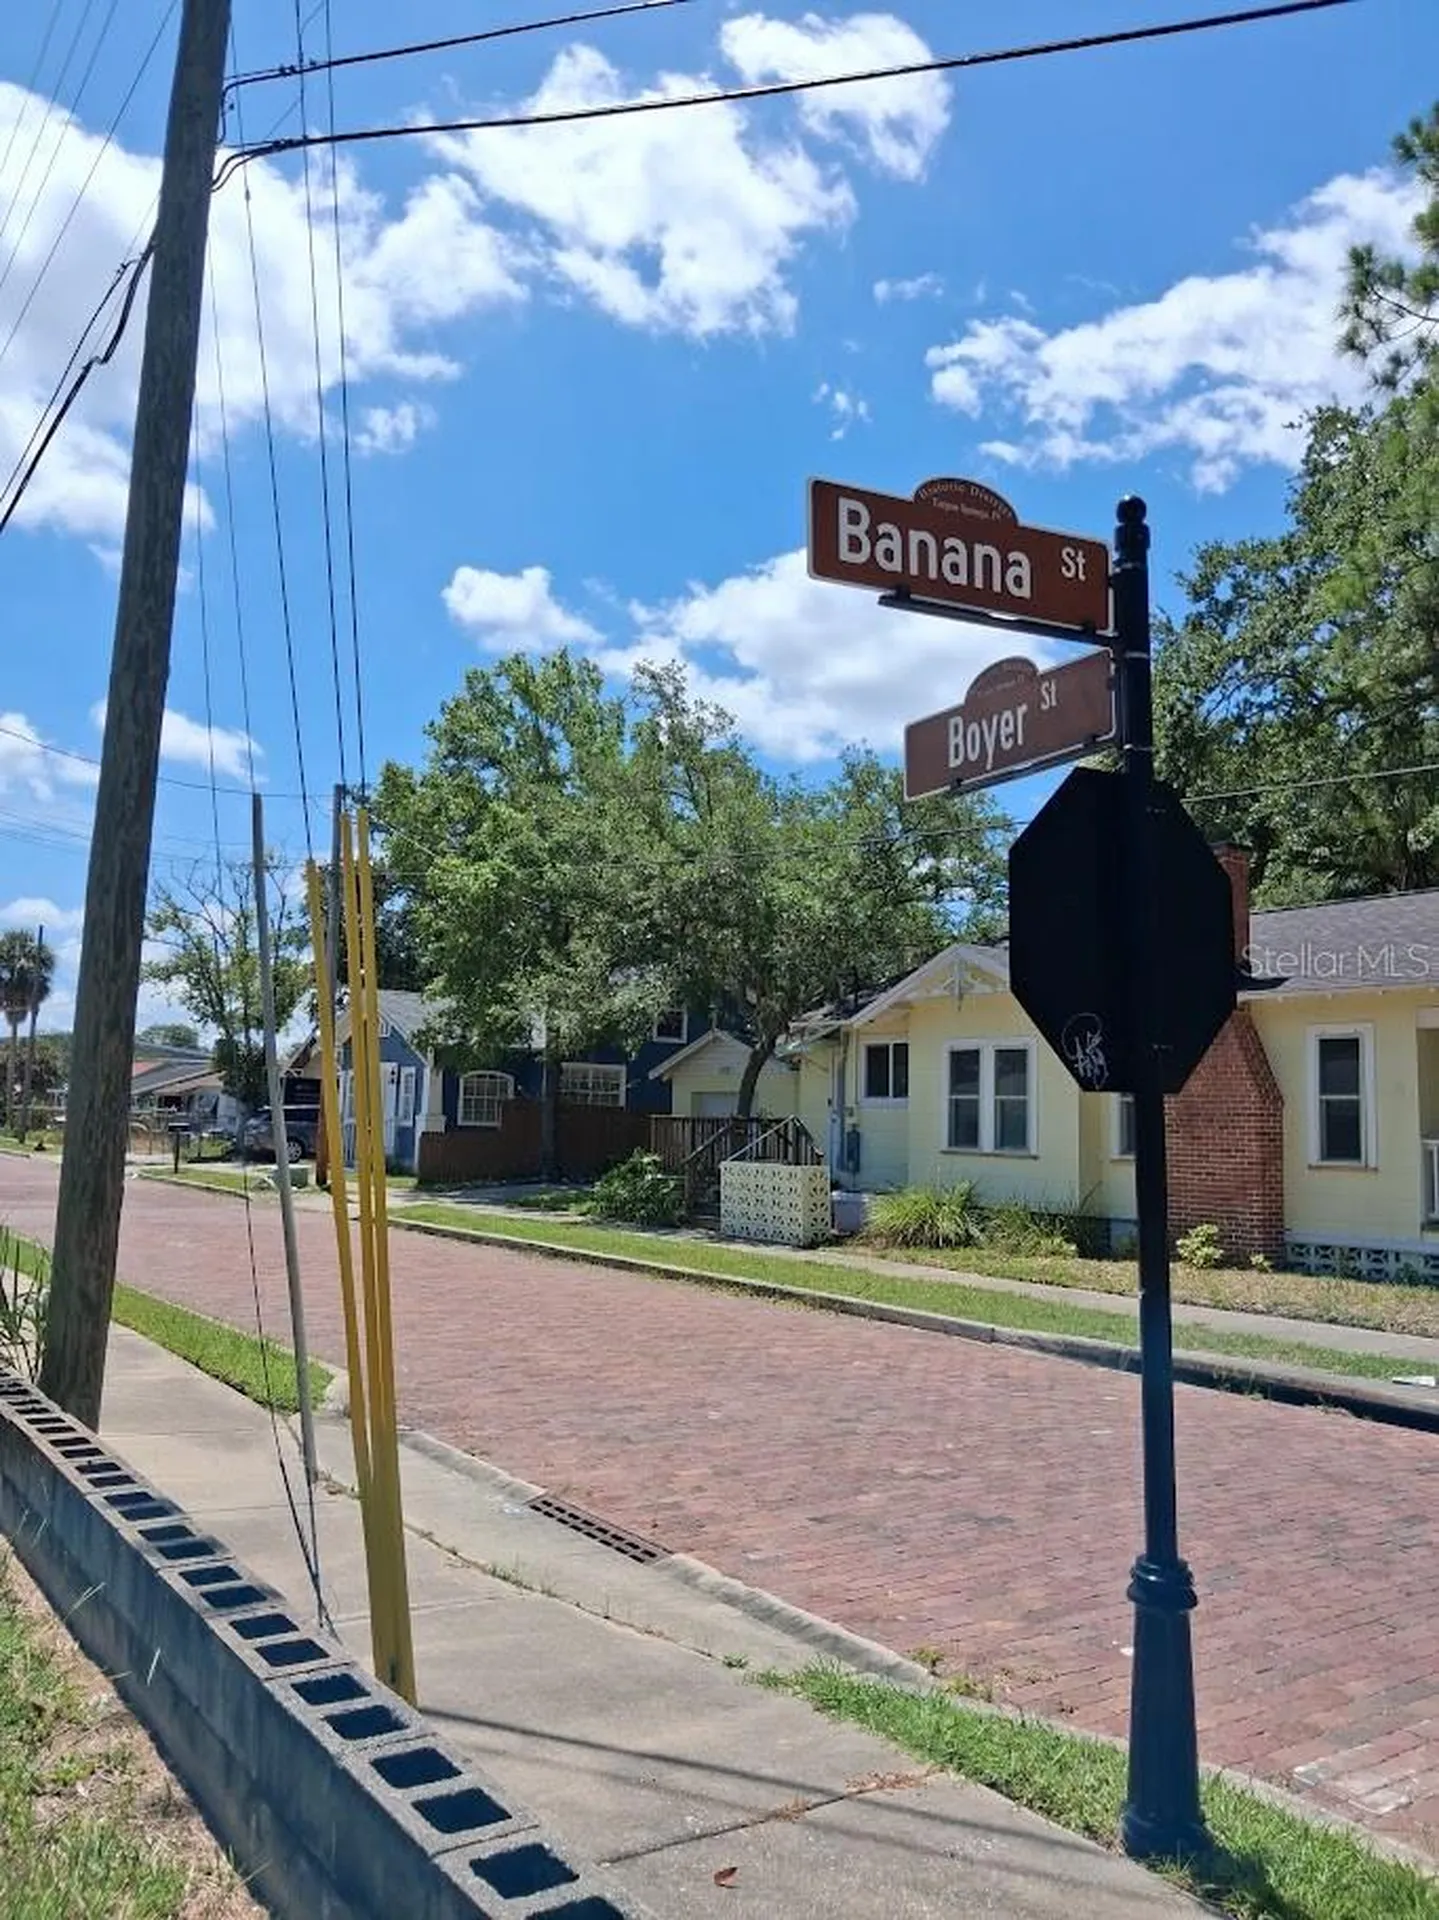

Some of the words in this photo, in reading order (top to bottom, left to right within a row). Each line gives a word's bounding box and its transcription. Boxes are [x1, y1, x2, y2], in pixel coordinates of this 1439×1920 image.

[837, 496, 1032, 599] Banana
[1060, 546, 1087, 582] St
[948, 704, 1029, 771] Boyer
[1040, 678, 1058, 711] St
